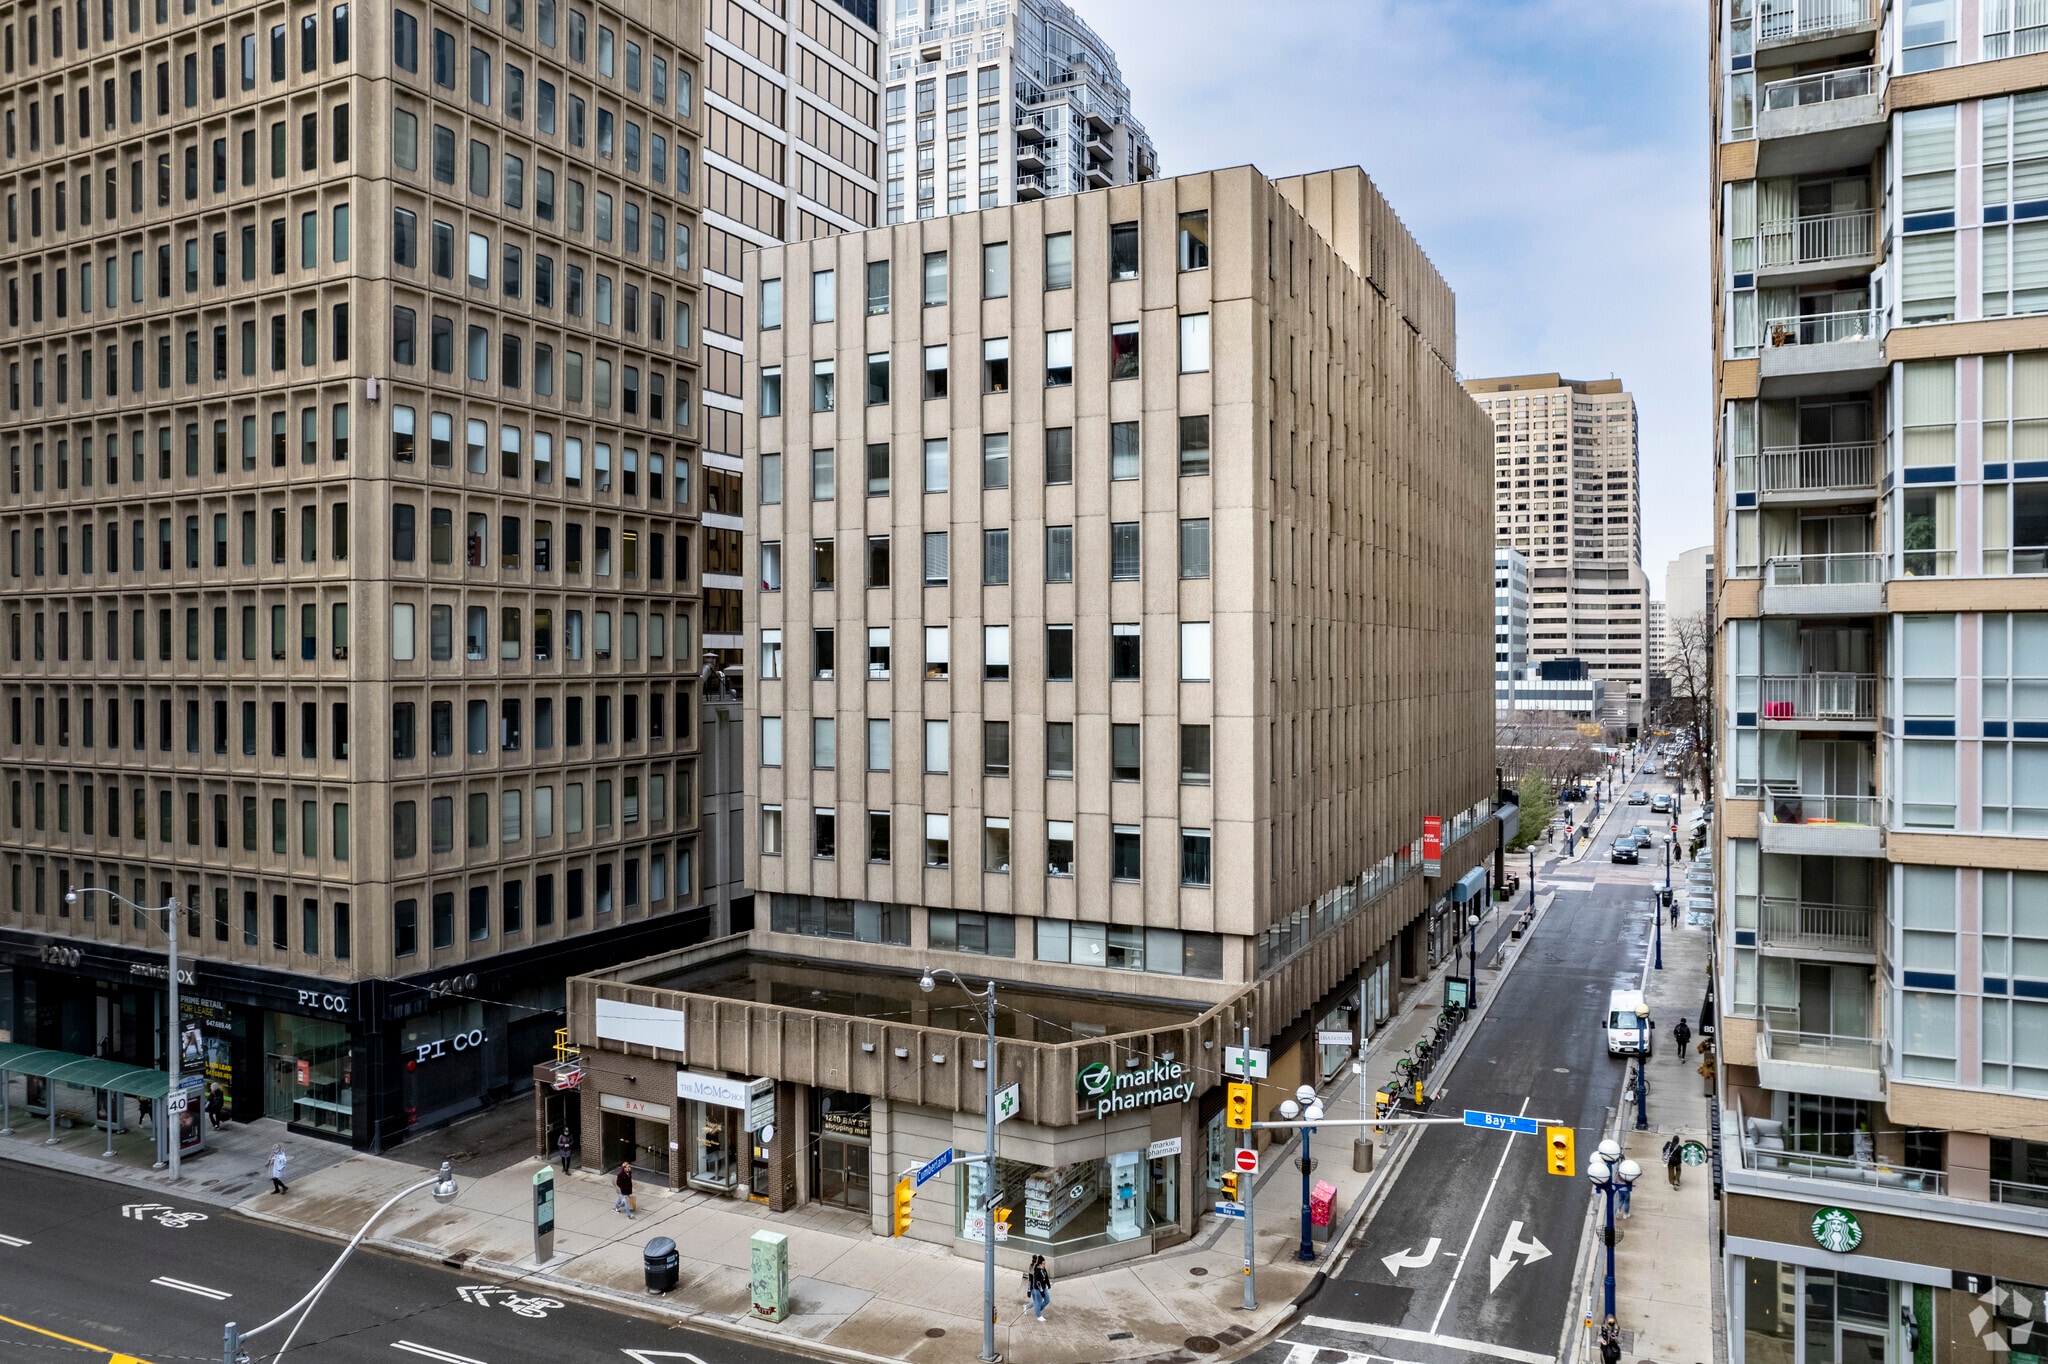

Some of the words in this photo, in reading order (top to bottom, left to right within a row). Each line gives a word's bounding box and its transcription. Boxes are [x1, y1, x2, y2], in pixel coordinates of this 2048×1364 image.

[40, 944, 81, 967] 1200
[428, 973, 477, 999] 1200
[180, 994, 200, 1005] PRIME
[200, 998, 224, 1009] RETAIL
[298, 990, 319, 1008] PI
[322, 994, 348, 1013] CO.
[180, 1002, 193, 1012] FOR
[193, 1005, 214, 1017] LEASE
[416, 1039, 446, 1064] PI
[453, 1029, 489, 1051] CO.
[1115, 1059, 1182, 1090] markie
[681, 1083, 693, 1093] THE
[169, 1098, 186, 1111] 40
[625, 1100, 645, 1111] BAY
[1097, 1080, 1195, 1121] pharmacy
[825, 1114, 841, 1123] 1240
[842, 1117, 857, 1126] BAY
[858, 1120, 868, 1128] ST
[825, 1122, 853, 1134] shopping
[854, 1127, 868, 1135] mall
[1485, 1114, 1506, 1129] Bay
[1147, 1145, 1180, 1159] pharmacy
[1152, 1140, 1175, 1150] markie
[918, 1152, 947, 1183] Cumberland
